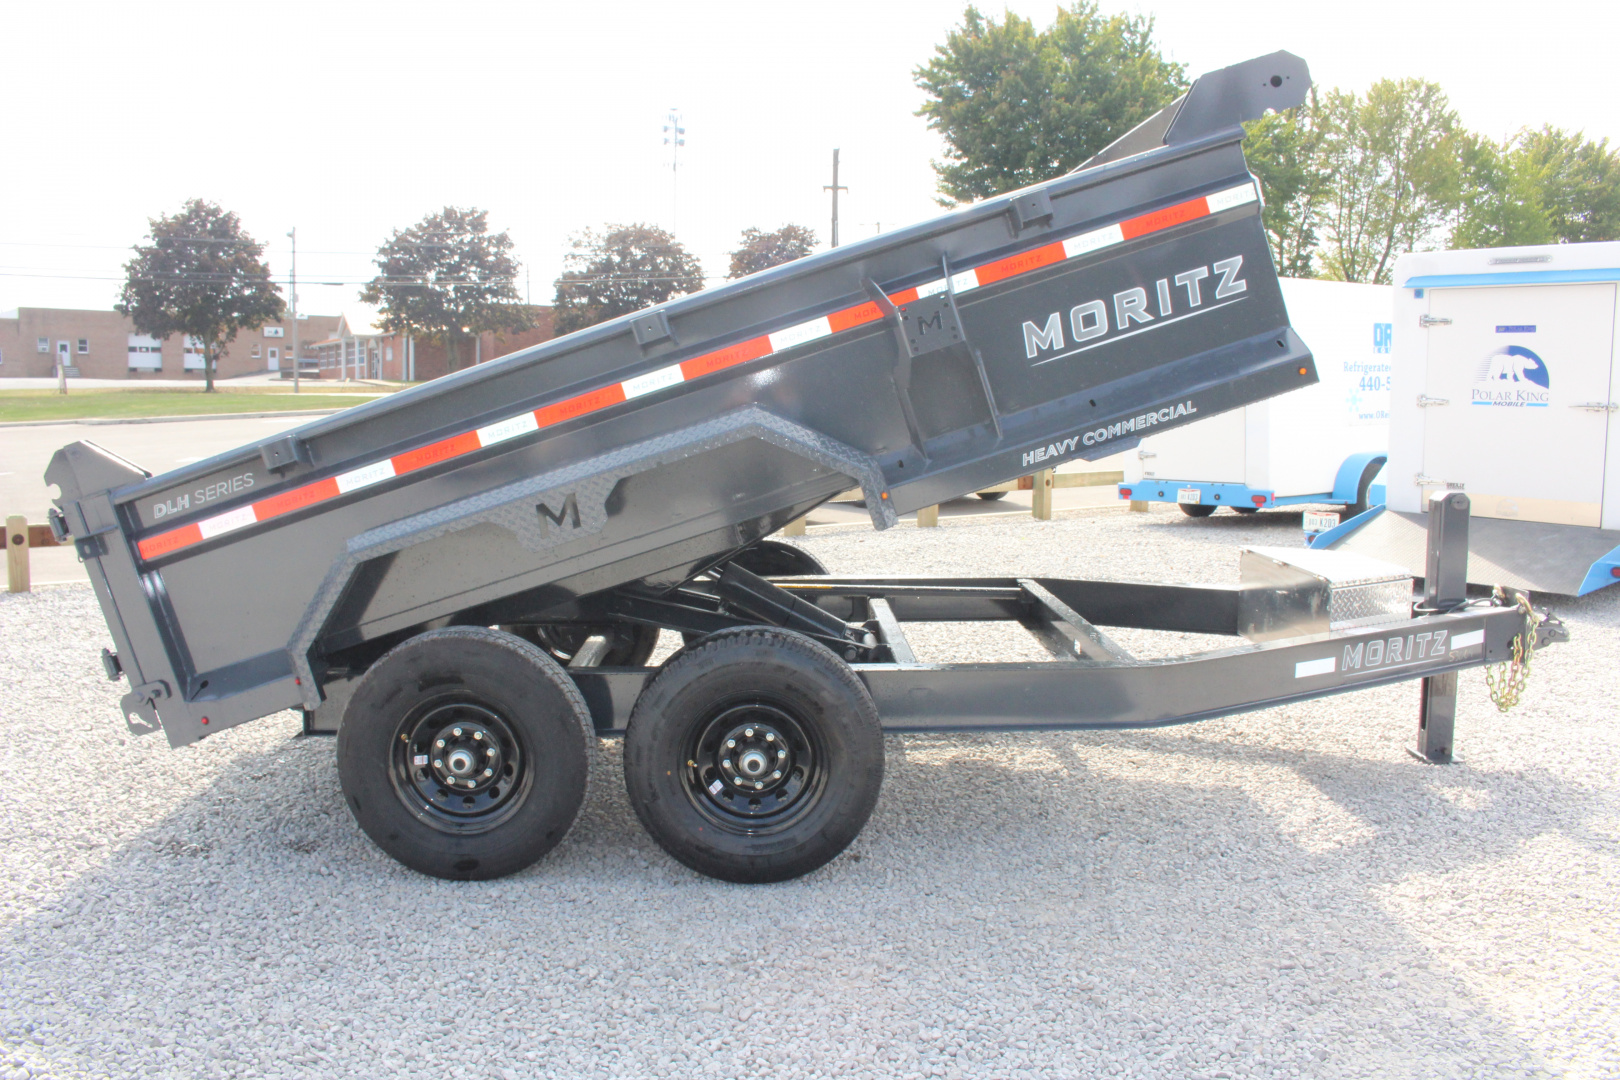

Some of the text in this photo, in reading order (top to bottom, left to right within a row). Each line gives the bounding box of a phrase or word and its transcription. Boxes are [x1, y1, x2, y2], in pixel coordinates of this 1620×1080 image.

[1146, 209, 1186, 228] MORITZ
[1073, 232, 1114, 250] MORITZ
[1001, 254, 1042, 273] MORITZ
[1022, 255, 1248, 359] MORITZ
[917, 310, 943, 336] M
[780, 325, 822, 343] MORITZ
[706, 350, 749, 368] MORITZ
[633, 372, 674, 392] MORITZ
[1471, 388, 1549, 402] POLAR KING
[559, 396, 601, 415] MORITZ
[487, 420, 528, 439] MORITZ
[1022, 401, 1198, 467] HEAVY COMMERCIAL
[416, 444, 456, 463] MORITZ
[345, 466, 386, 486] MORITZ
[153, 472, 255, 519] DLH SERIES
[535, 492, 582, 540] M
[1341, 629, 1448, 671] MORITZ
